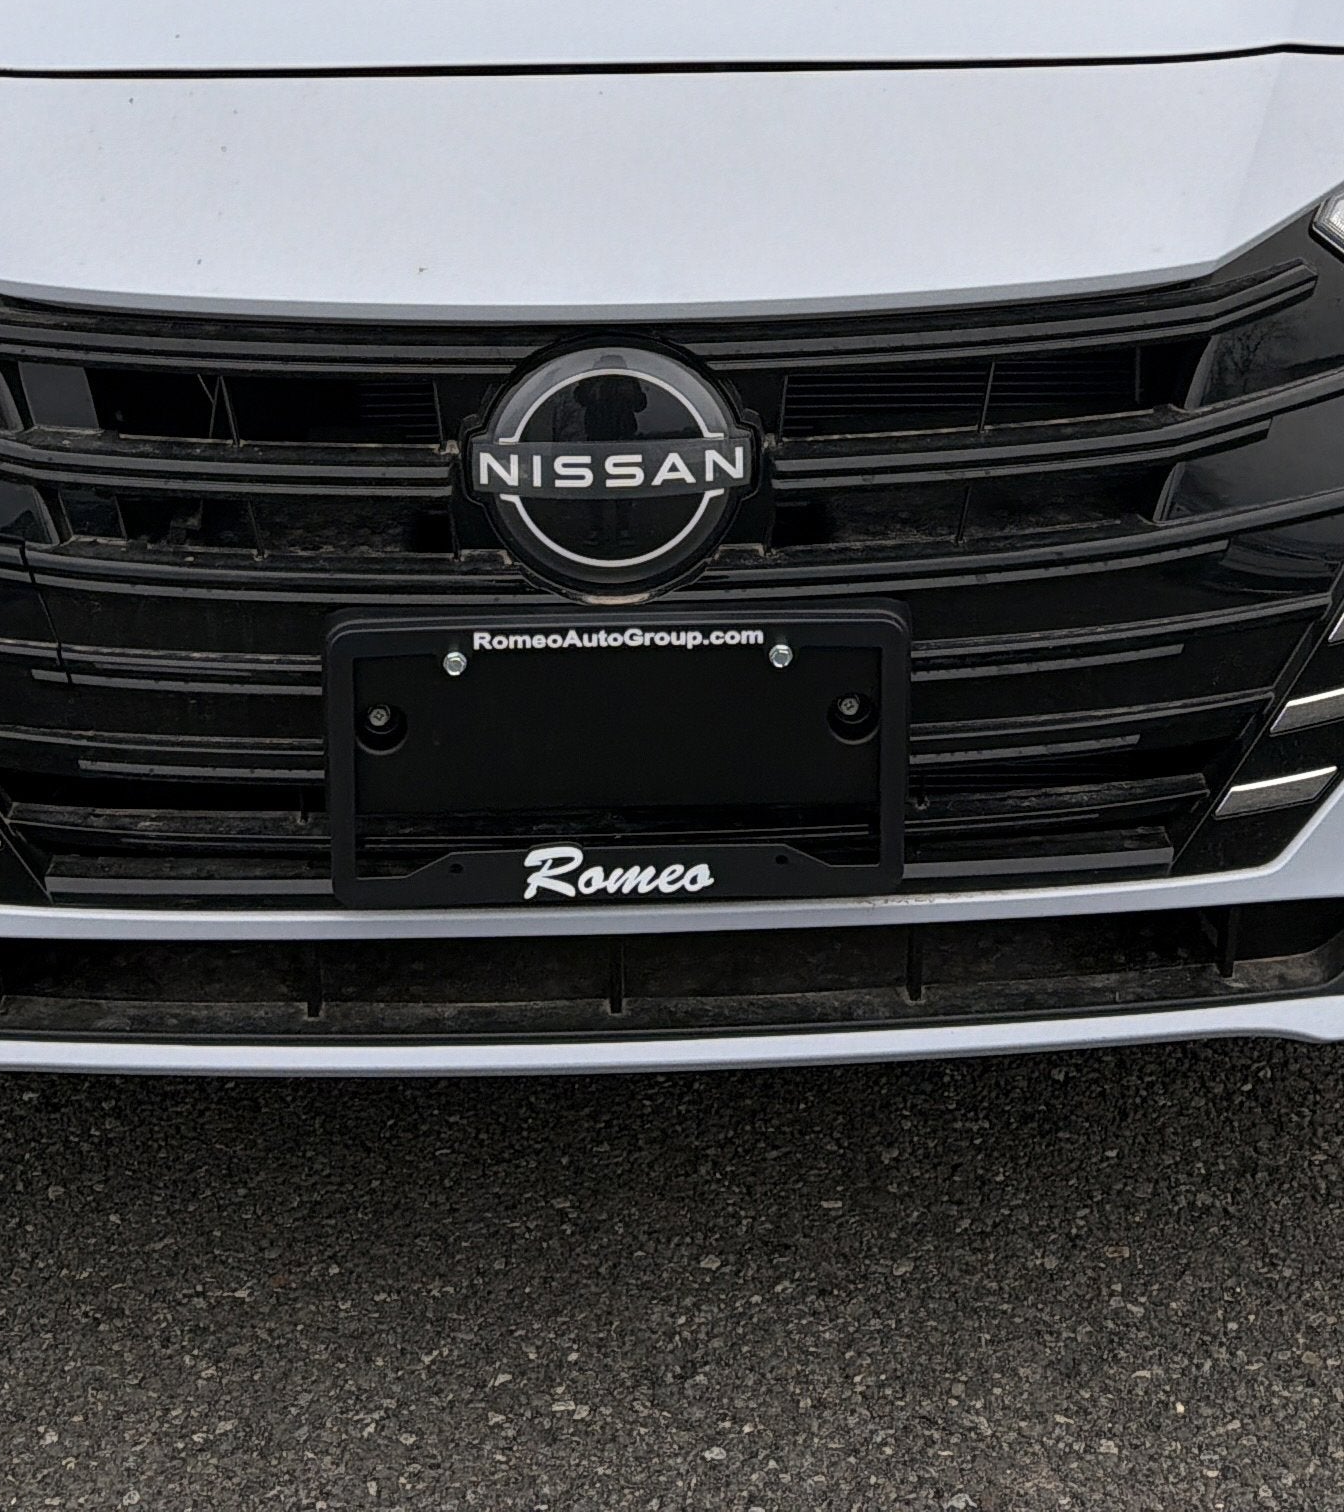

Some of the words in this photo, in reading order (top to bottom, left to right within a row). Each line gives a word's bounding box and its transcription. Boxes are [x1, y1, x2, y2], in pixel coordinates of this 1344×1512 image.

[479, 446, 744, 488] NISSAN
[473, 628, 764, 650] RomeoAutoGroup.com
[523, 846, 715, 900] Romeo
